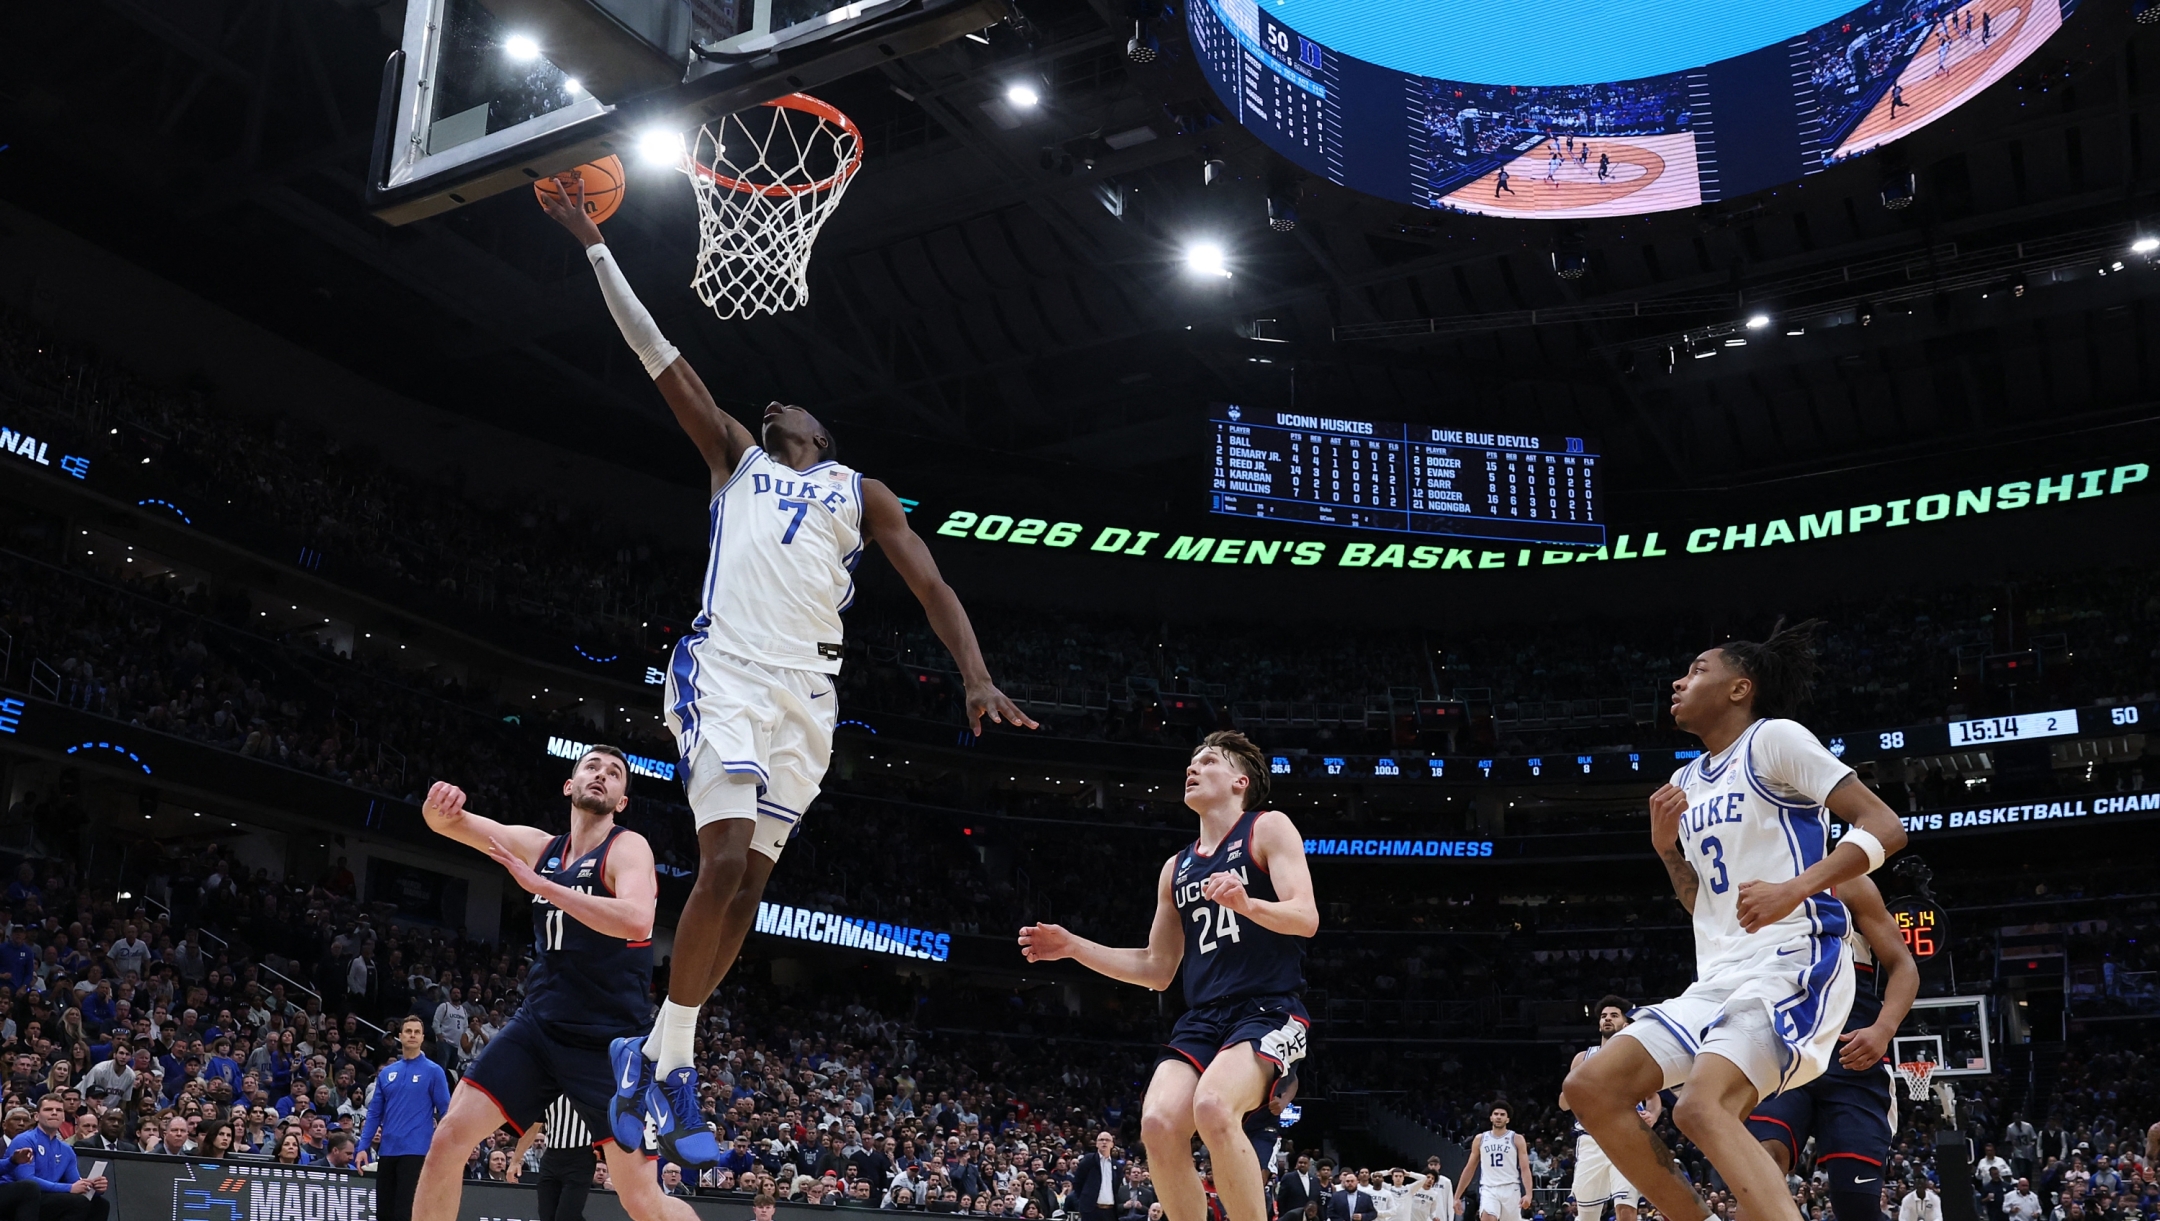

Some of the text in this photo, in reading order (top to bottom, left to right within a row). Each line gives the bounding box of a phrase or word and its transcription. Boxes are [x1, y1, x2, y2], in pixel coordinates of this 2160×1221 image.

[1268, 22, 1289, 52] 50
[1277, 413, 1373, 434] UCONN HUSKIES
[1217, 434, 1395, 462] 1 BALL 4 0 1 0 0 2
[1432, 429, 1539, 449] DUKE BLUE DEVILS
[1216, 445, 1395, 474] 2 DEMARY JR. 4 4 1 0 1 1
[1216, 456, 1396, 484] 5 REED JR. 14 3 0 0 4 2
[1414, 456, 1590, 477] 2 BOOZER 15 4 4 2 0 0
[1214, 467, 1396, 496] 11 KARABAN 0 2 0 0 2 1
[1414, 466, 1591, 488] 3 EVANS 5 0 0 0 2 2
[1414, 477, 1592, 499] 7 SARR 8 3 1 0 0 0
[752, 473, 846, 514] DUKE
[1214, 478, 1396, 507] 24 MULLINS 7 1 0 0 0 2
[1412, 488, 1592, 510] 12 BOOZER 16 6 3 0 2 1
[778, 498, 808, 544] 7
[936, 463, 2150, 569] 2026 DI MEN'S BASKETBALL CHAMPIONSHIP
[1413, 499, 1593, 521] 21 NGONGBA 4 4 3 1 1 1
[2111, 706, 2138, 725] 50
[1880, 731, 1904, 749] 38
[1959, 718, 2058, 742] 15:14 2
[1528, 758, 1542, 766] STL
[1577, 756, 1592, 764] BLK
[1675, 750, 1701, 759] BONUS
[1271, 764, 1291, 774] 36.4
[1328, 765, 1341, 774] 6.7
[1375, 766, 1399, 775] 100.0
[1432, 768, 1443, 777] 18
[1484, 768, 1490, 777] 7
[1532, 766, 1540, 776] 0
[1583, 764, 1590, 773] 8
[1632, 762, 1639, 771] 4
[1680, 793, 1744, 842] DUKE
[1899, 794, 2160, 832] EN'S BASKETBALL CHAM
[1303, 838, 1493, 857] #MARCHMADNESS
[1701, 836, 1729, 894] 3
[1176, 865, 1249, 908] UCN
[1192, 904, 1240, 954] 24
[1895, 910, 1934, 927] 15:14
[546, 910, 564, 950] 11
[755, 901, 951, 962] MARCHMADNESS
[1484, 1144, 1510, 1153] DUKE
[1490, 1153, 1503, 1167] 12
